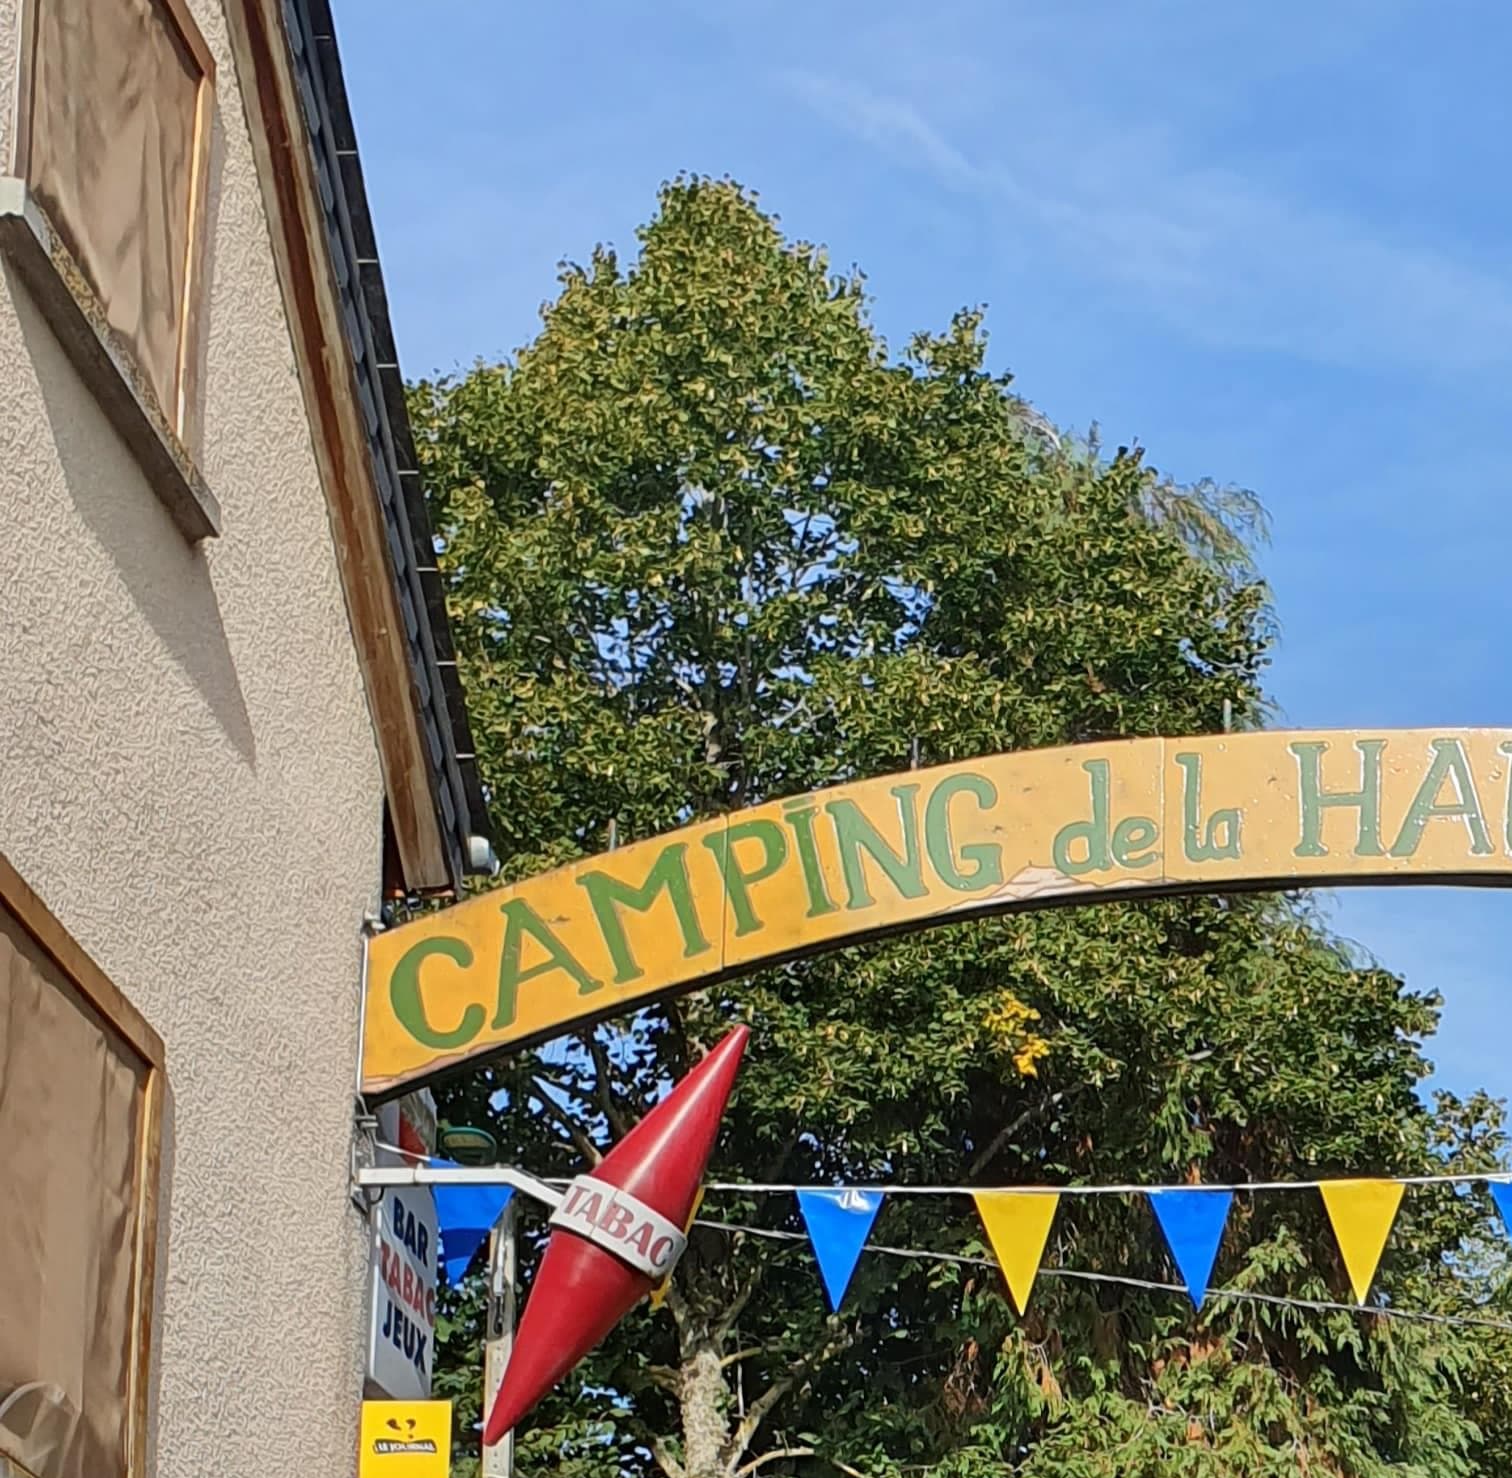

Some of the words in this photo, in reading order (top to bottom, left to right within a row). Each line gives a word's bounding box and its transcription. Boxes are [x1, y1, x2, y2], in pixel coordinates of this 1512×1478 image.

[389, 771, 1002, 1050] CAMPING
[1052, 758, 1159, 875] de
[1175, 752, 1243, 863] la
[393, 1196, 429, 1268] BAR
[563, 1185, 675, 1268] TABAC
[379, 1240, 435, 1329] TABAC
[383, 1300, 427, 1375] JEUX
